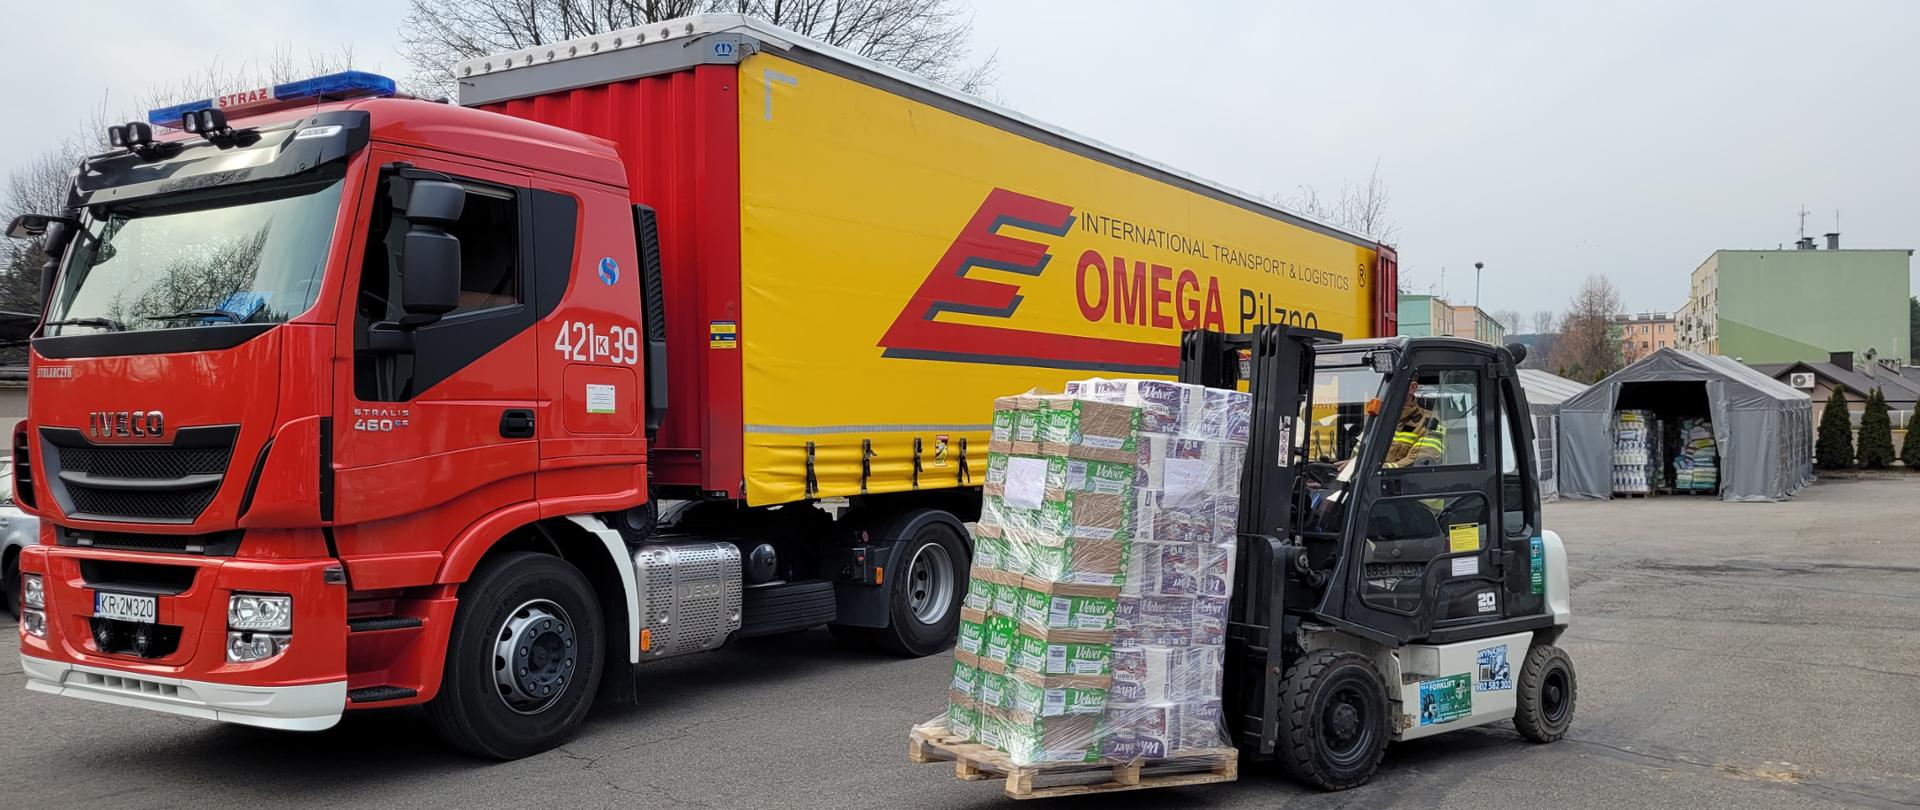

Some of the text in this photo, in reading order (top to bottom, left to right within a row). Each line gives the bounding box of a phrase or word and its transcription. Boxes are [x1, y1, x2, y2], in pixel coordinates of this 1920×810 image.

[1081, 211, 1350, 291] INTERNATIONAL TRANSPORT & LOGISTICS
[1075, 250, 1226, 334] OMEGA
[555, 321, 594, 362] 421
[610, 325, 638, 365] 39
[89, 411, 164, 437] IVECO
[354, 408, 409, 417] STRALIS
[354, 418, 393, 432] 460
[102, 595, 154, 618] KR 2M320
